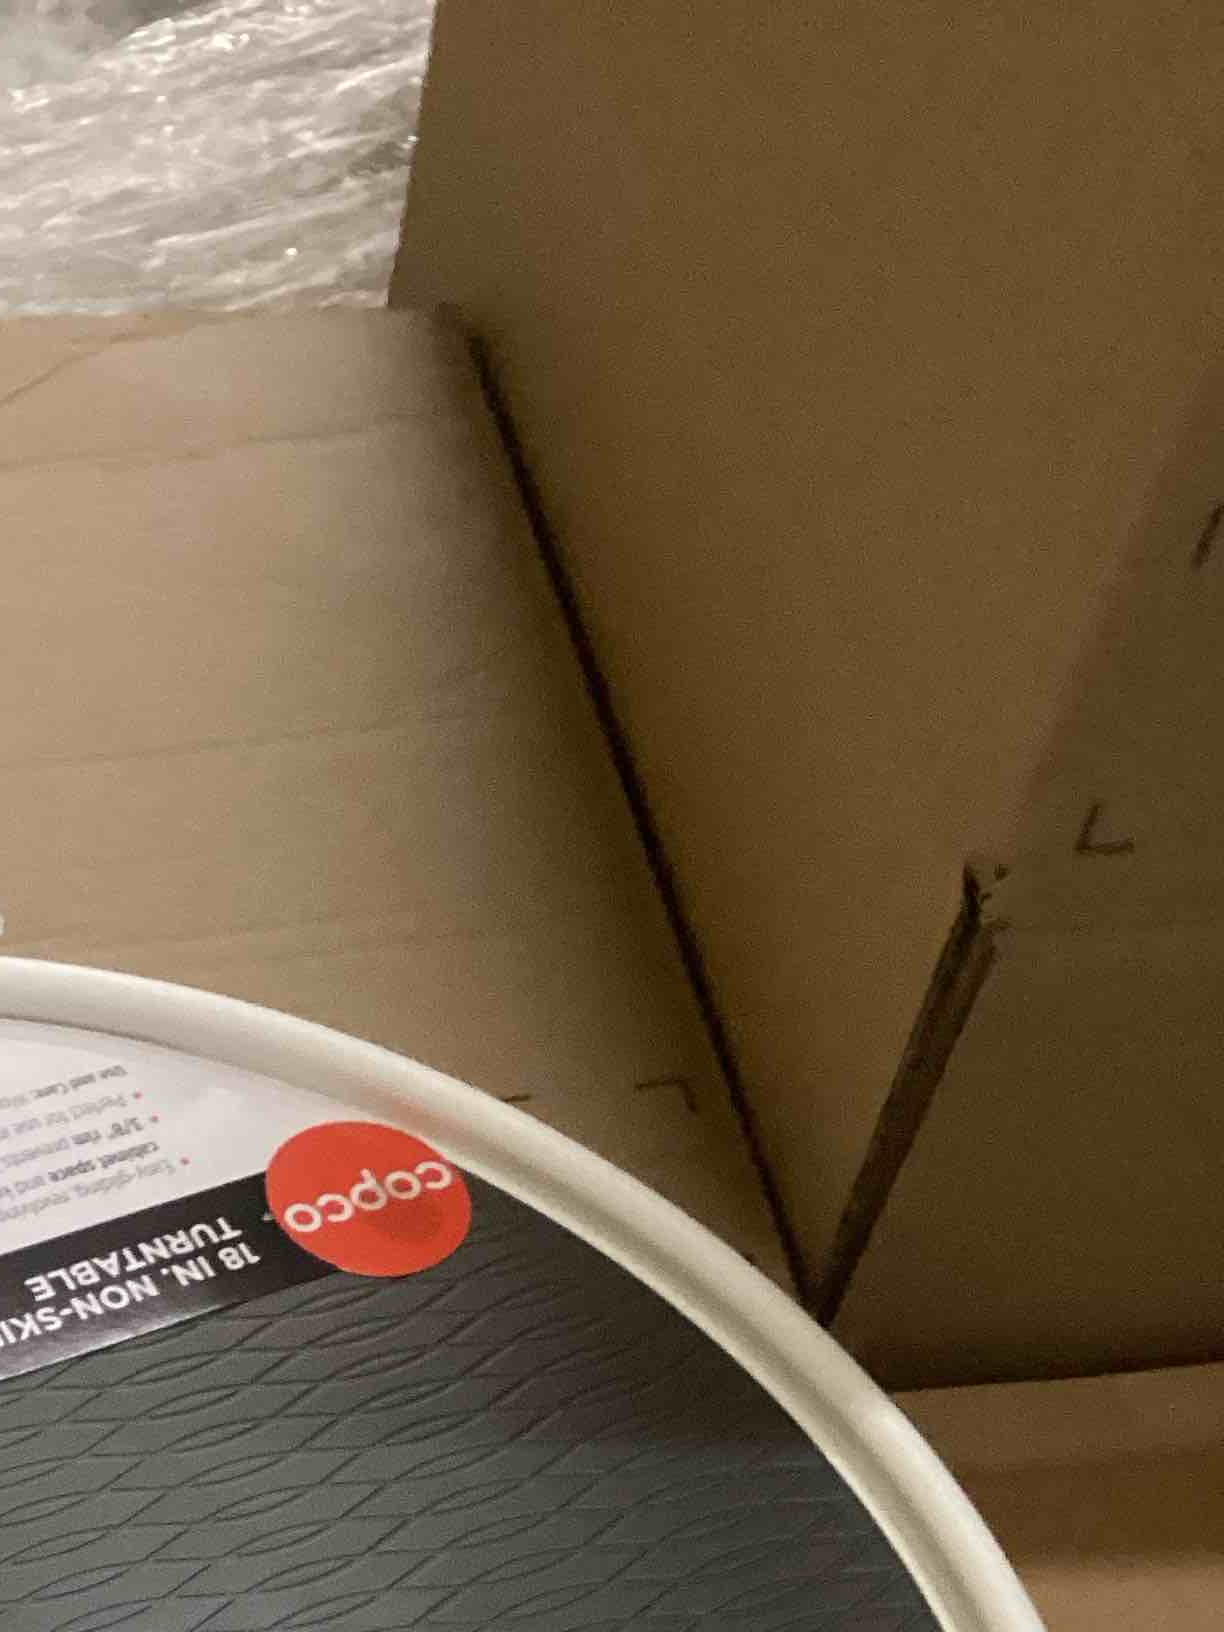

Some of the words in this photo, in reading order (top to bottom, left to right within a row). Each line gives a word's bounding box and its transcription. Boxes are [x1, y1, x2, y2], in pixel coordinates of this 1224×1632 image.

[49, 1159, 96, 1183] space
[284, 1160, 452, 1233] copco
[25, 1217, 242, 1300] TURNTABLE
[161, 1253, 216, 1292] IN.
[219, 1241, 261, 1274] 18
